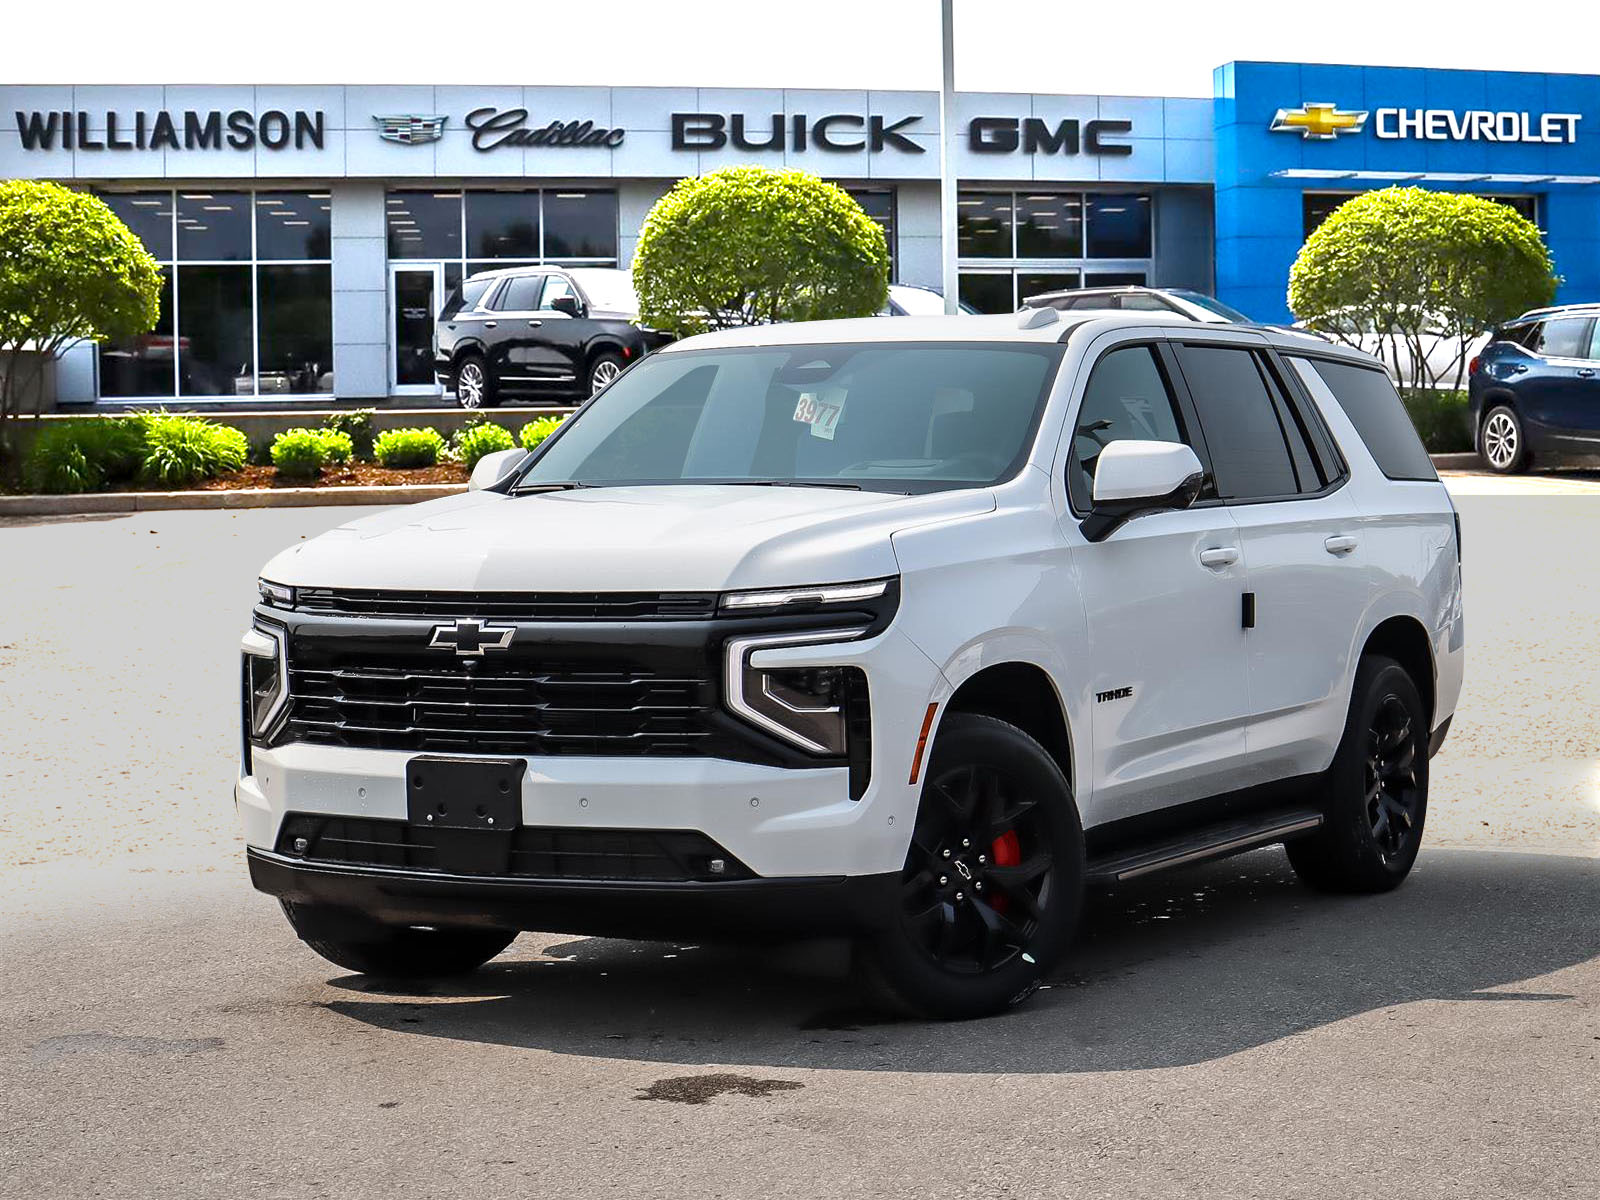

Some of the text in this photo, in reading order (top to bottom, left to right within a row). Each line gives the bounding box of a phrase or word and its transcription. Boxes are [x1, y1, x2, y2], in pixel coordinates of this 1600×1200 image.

[15, 110, 325, 151] WILLIAMSON
[465, 107, 625, 152] Cadillac
[671, 113, 926, 153] BUICK
[968, 116, 1133, 155] GMC
[1375, 107, 1582, 144] CHEVROLET
[796, 399, 840, 426] 3977
[1095, 686, 1133, 703] TAHOE
